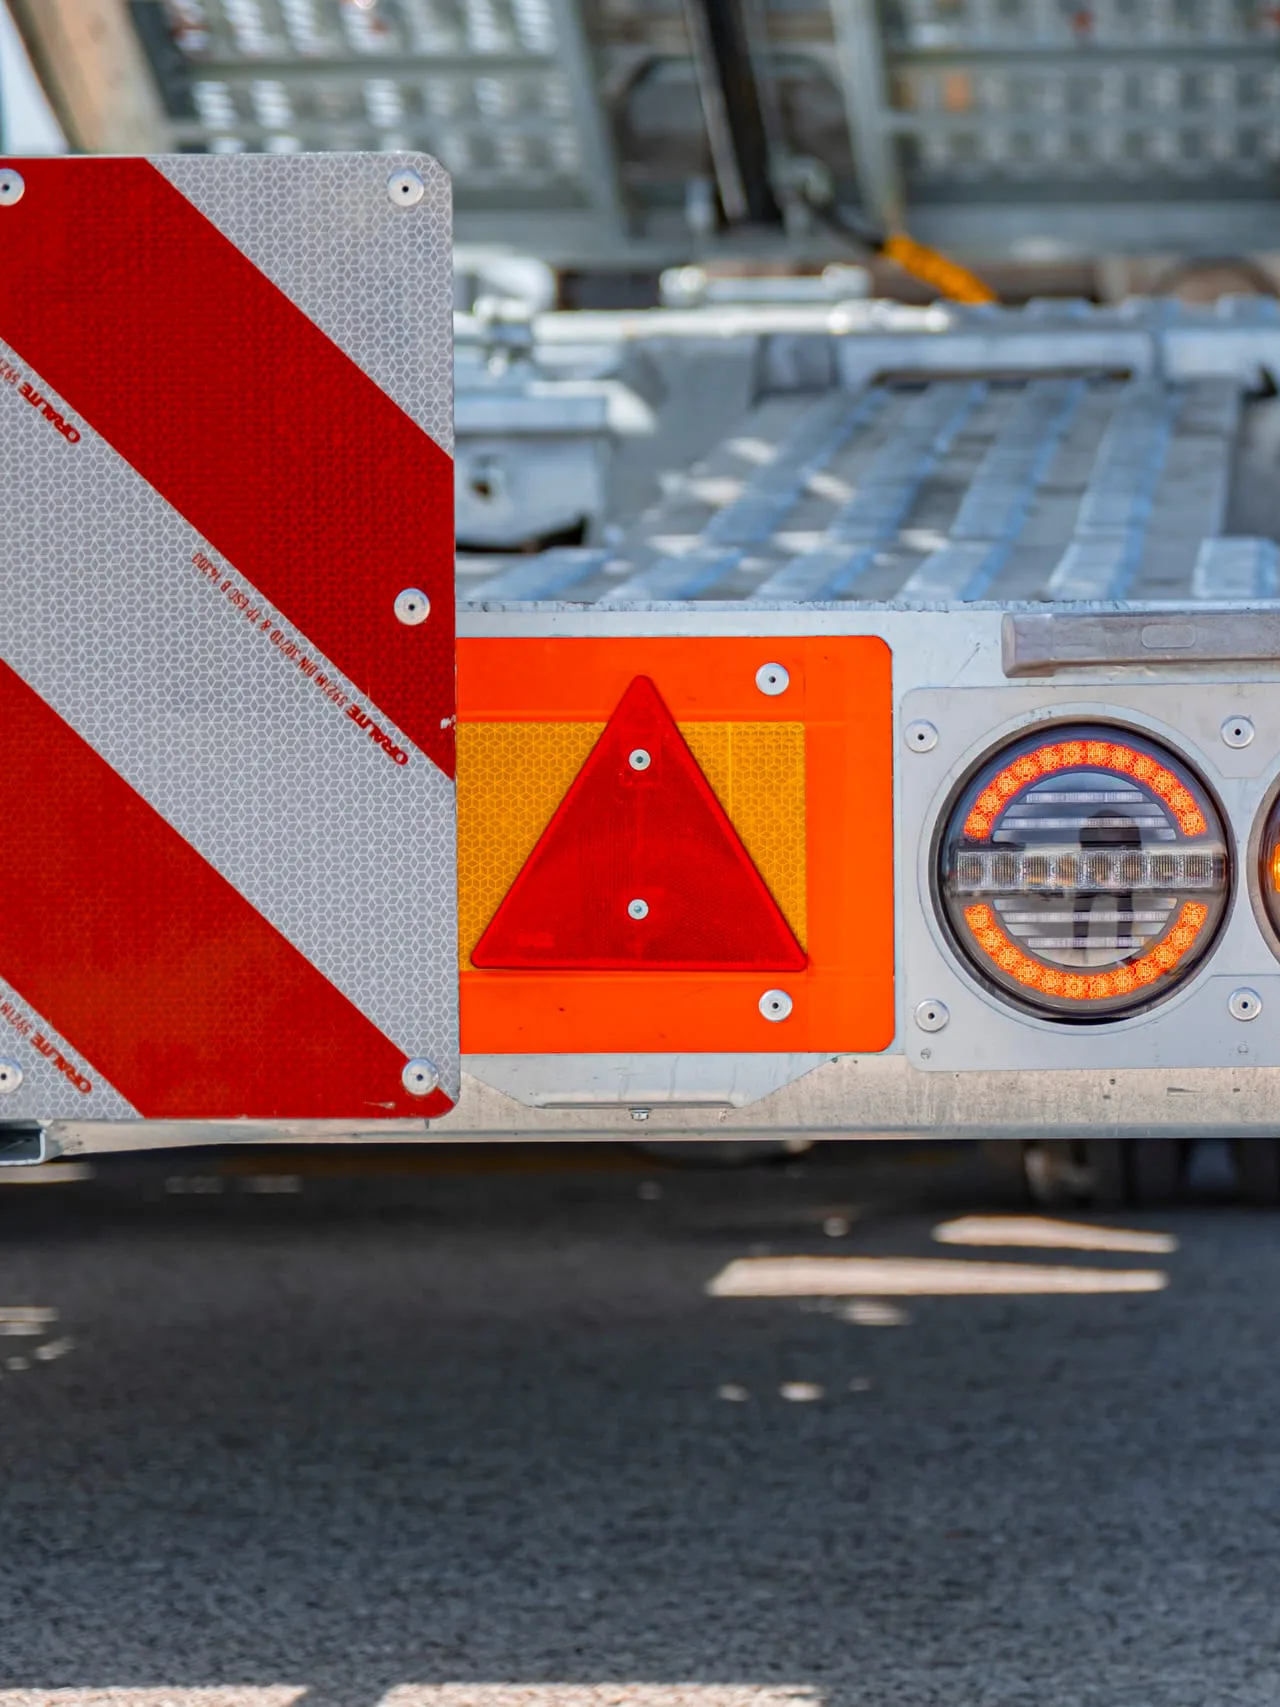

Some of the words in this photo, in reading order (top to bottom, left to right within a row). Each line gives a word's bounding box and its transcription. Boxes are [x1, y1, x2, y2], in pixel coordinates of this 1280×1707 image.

[19, 382, 80, 443] ORALITE
[221, 580, 232, 592] B
[260, 619, 271, 631] &
[270, 630, 300, 659] 30710
[299, 656, 318, 677] DIN
[346, 703, 408, 765] ORALITE
[31, 1031, 92, 1093] ORALITE
